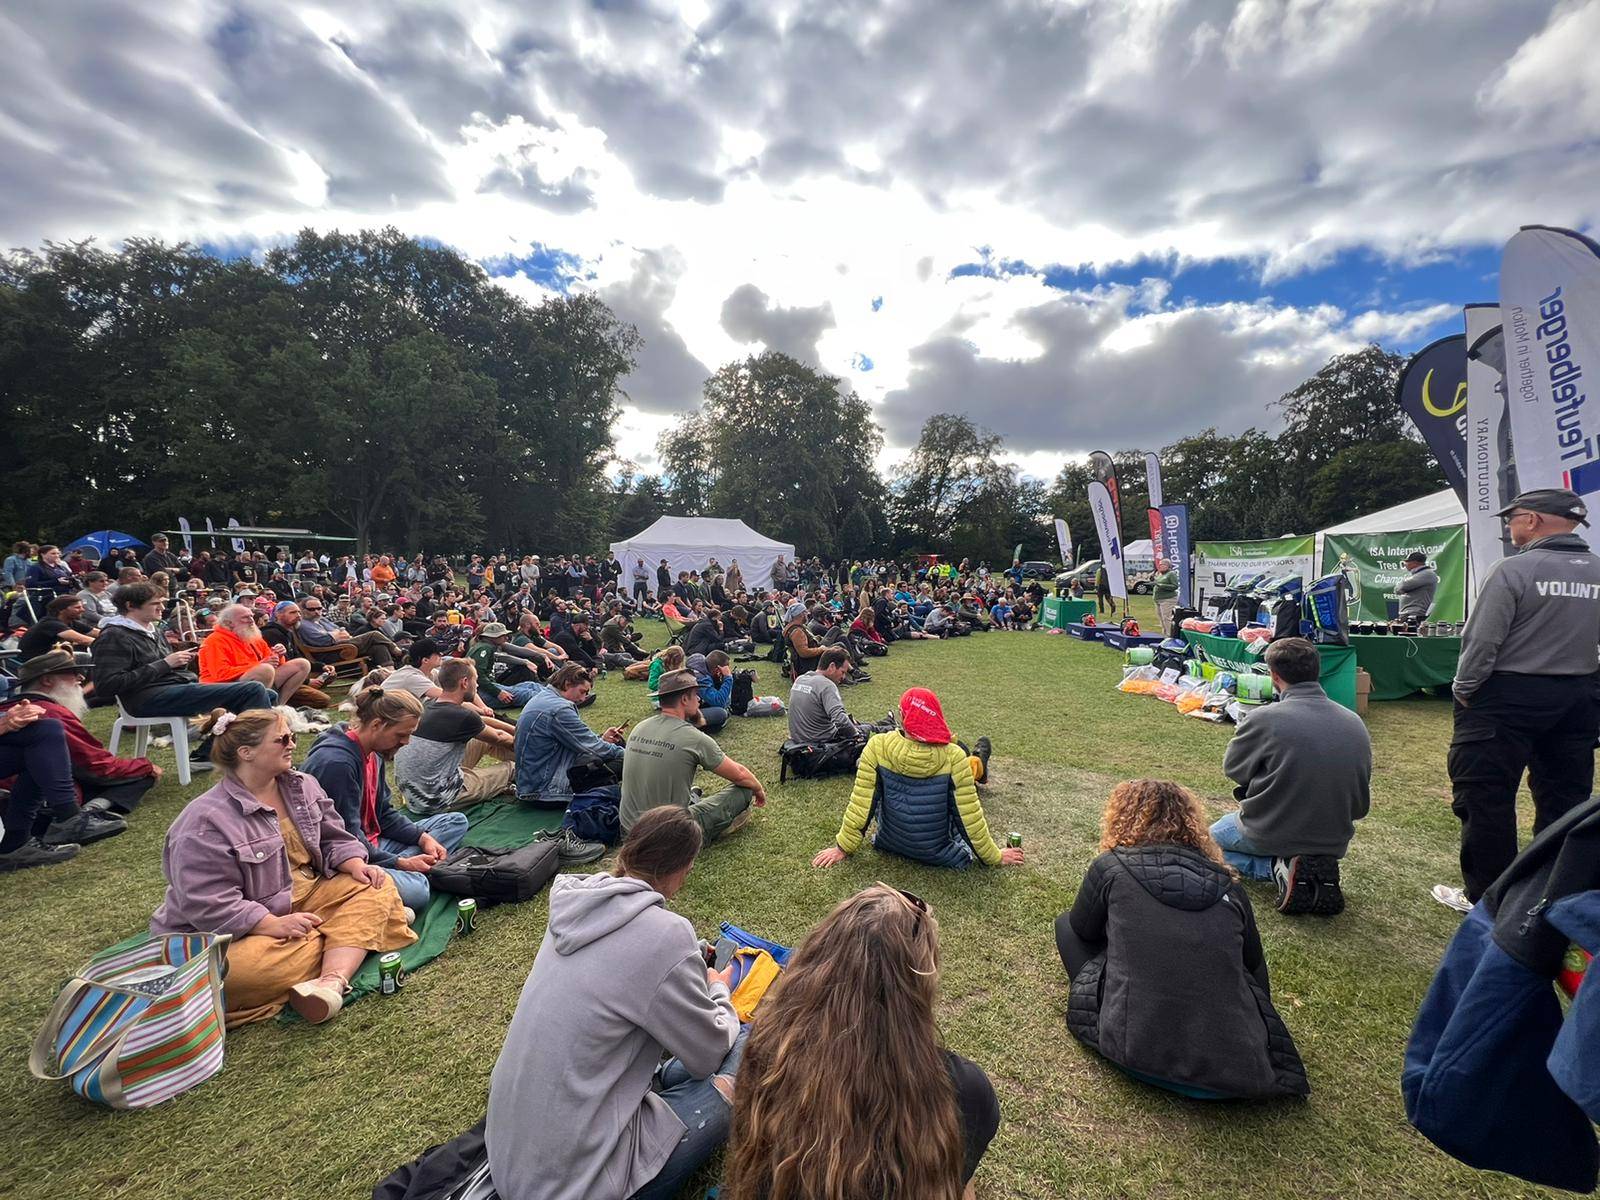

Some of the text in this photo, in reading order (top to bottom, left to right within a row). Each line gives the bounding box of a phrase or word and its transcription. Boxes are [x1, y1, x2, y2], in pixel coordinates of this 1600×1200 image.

[1369, 542, 1447, 557] ISA International
[1377, 560, 1398, 570] Tree
